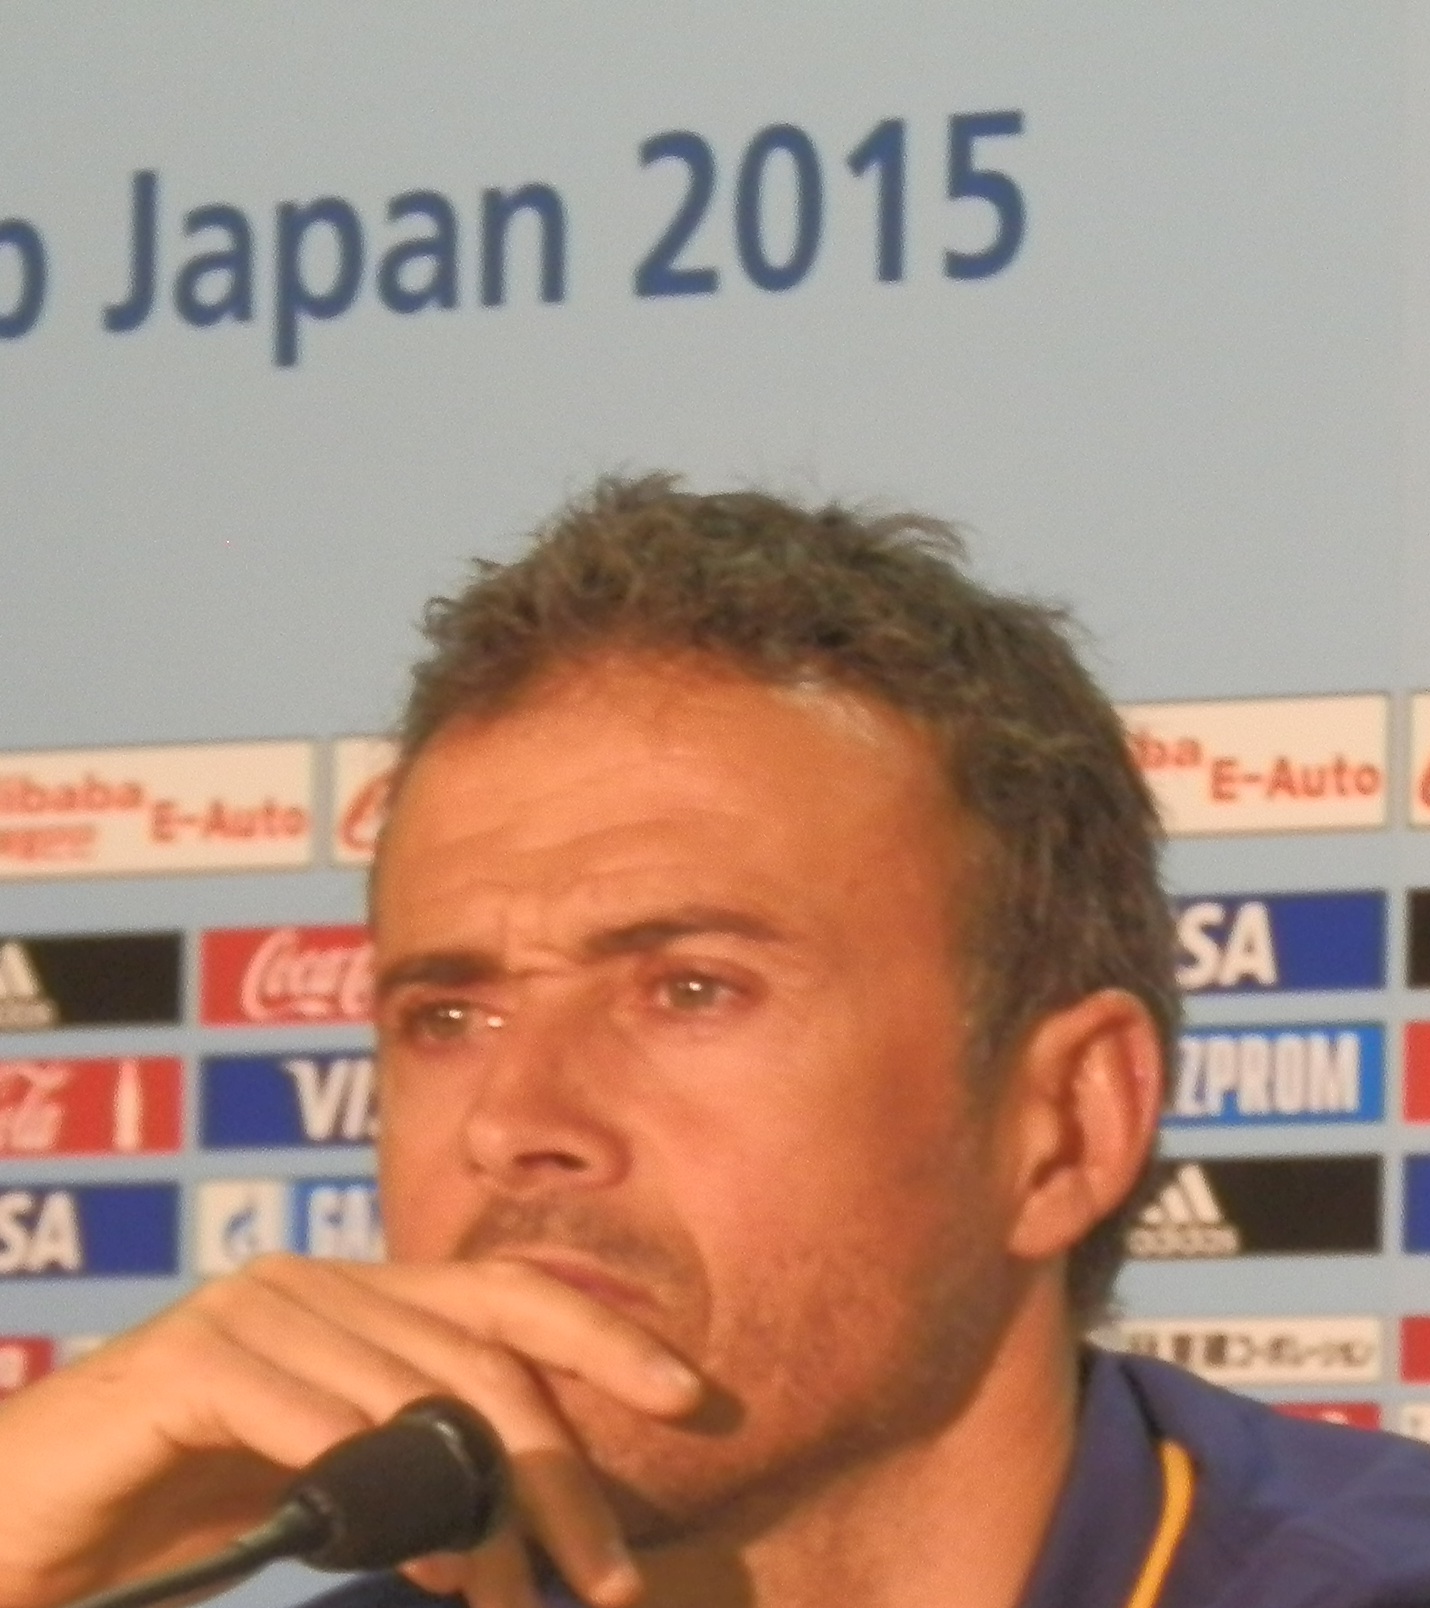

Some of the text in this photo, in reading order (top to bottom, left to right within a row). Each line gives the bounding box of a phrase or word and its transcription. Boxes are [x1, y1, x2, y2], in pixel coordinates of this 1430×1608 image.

[103, 169, 570, 369] Japan
[631, 109, 1030, 299] 2015
[1211, 755, 1383, 803] E-Auto
[147, 798, 307, 845] E-Auto
[1174, 899, 1279, 990] SA
[282, 1058, 377, 1142] VI
[1174, 1033, 1362, 1118] ZPROM
